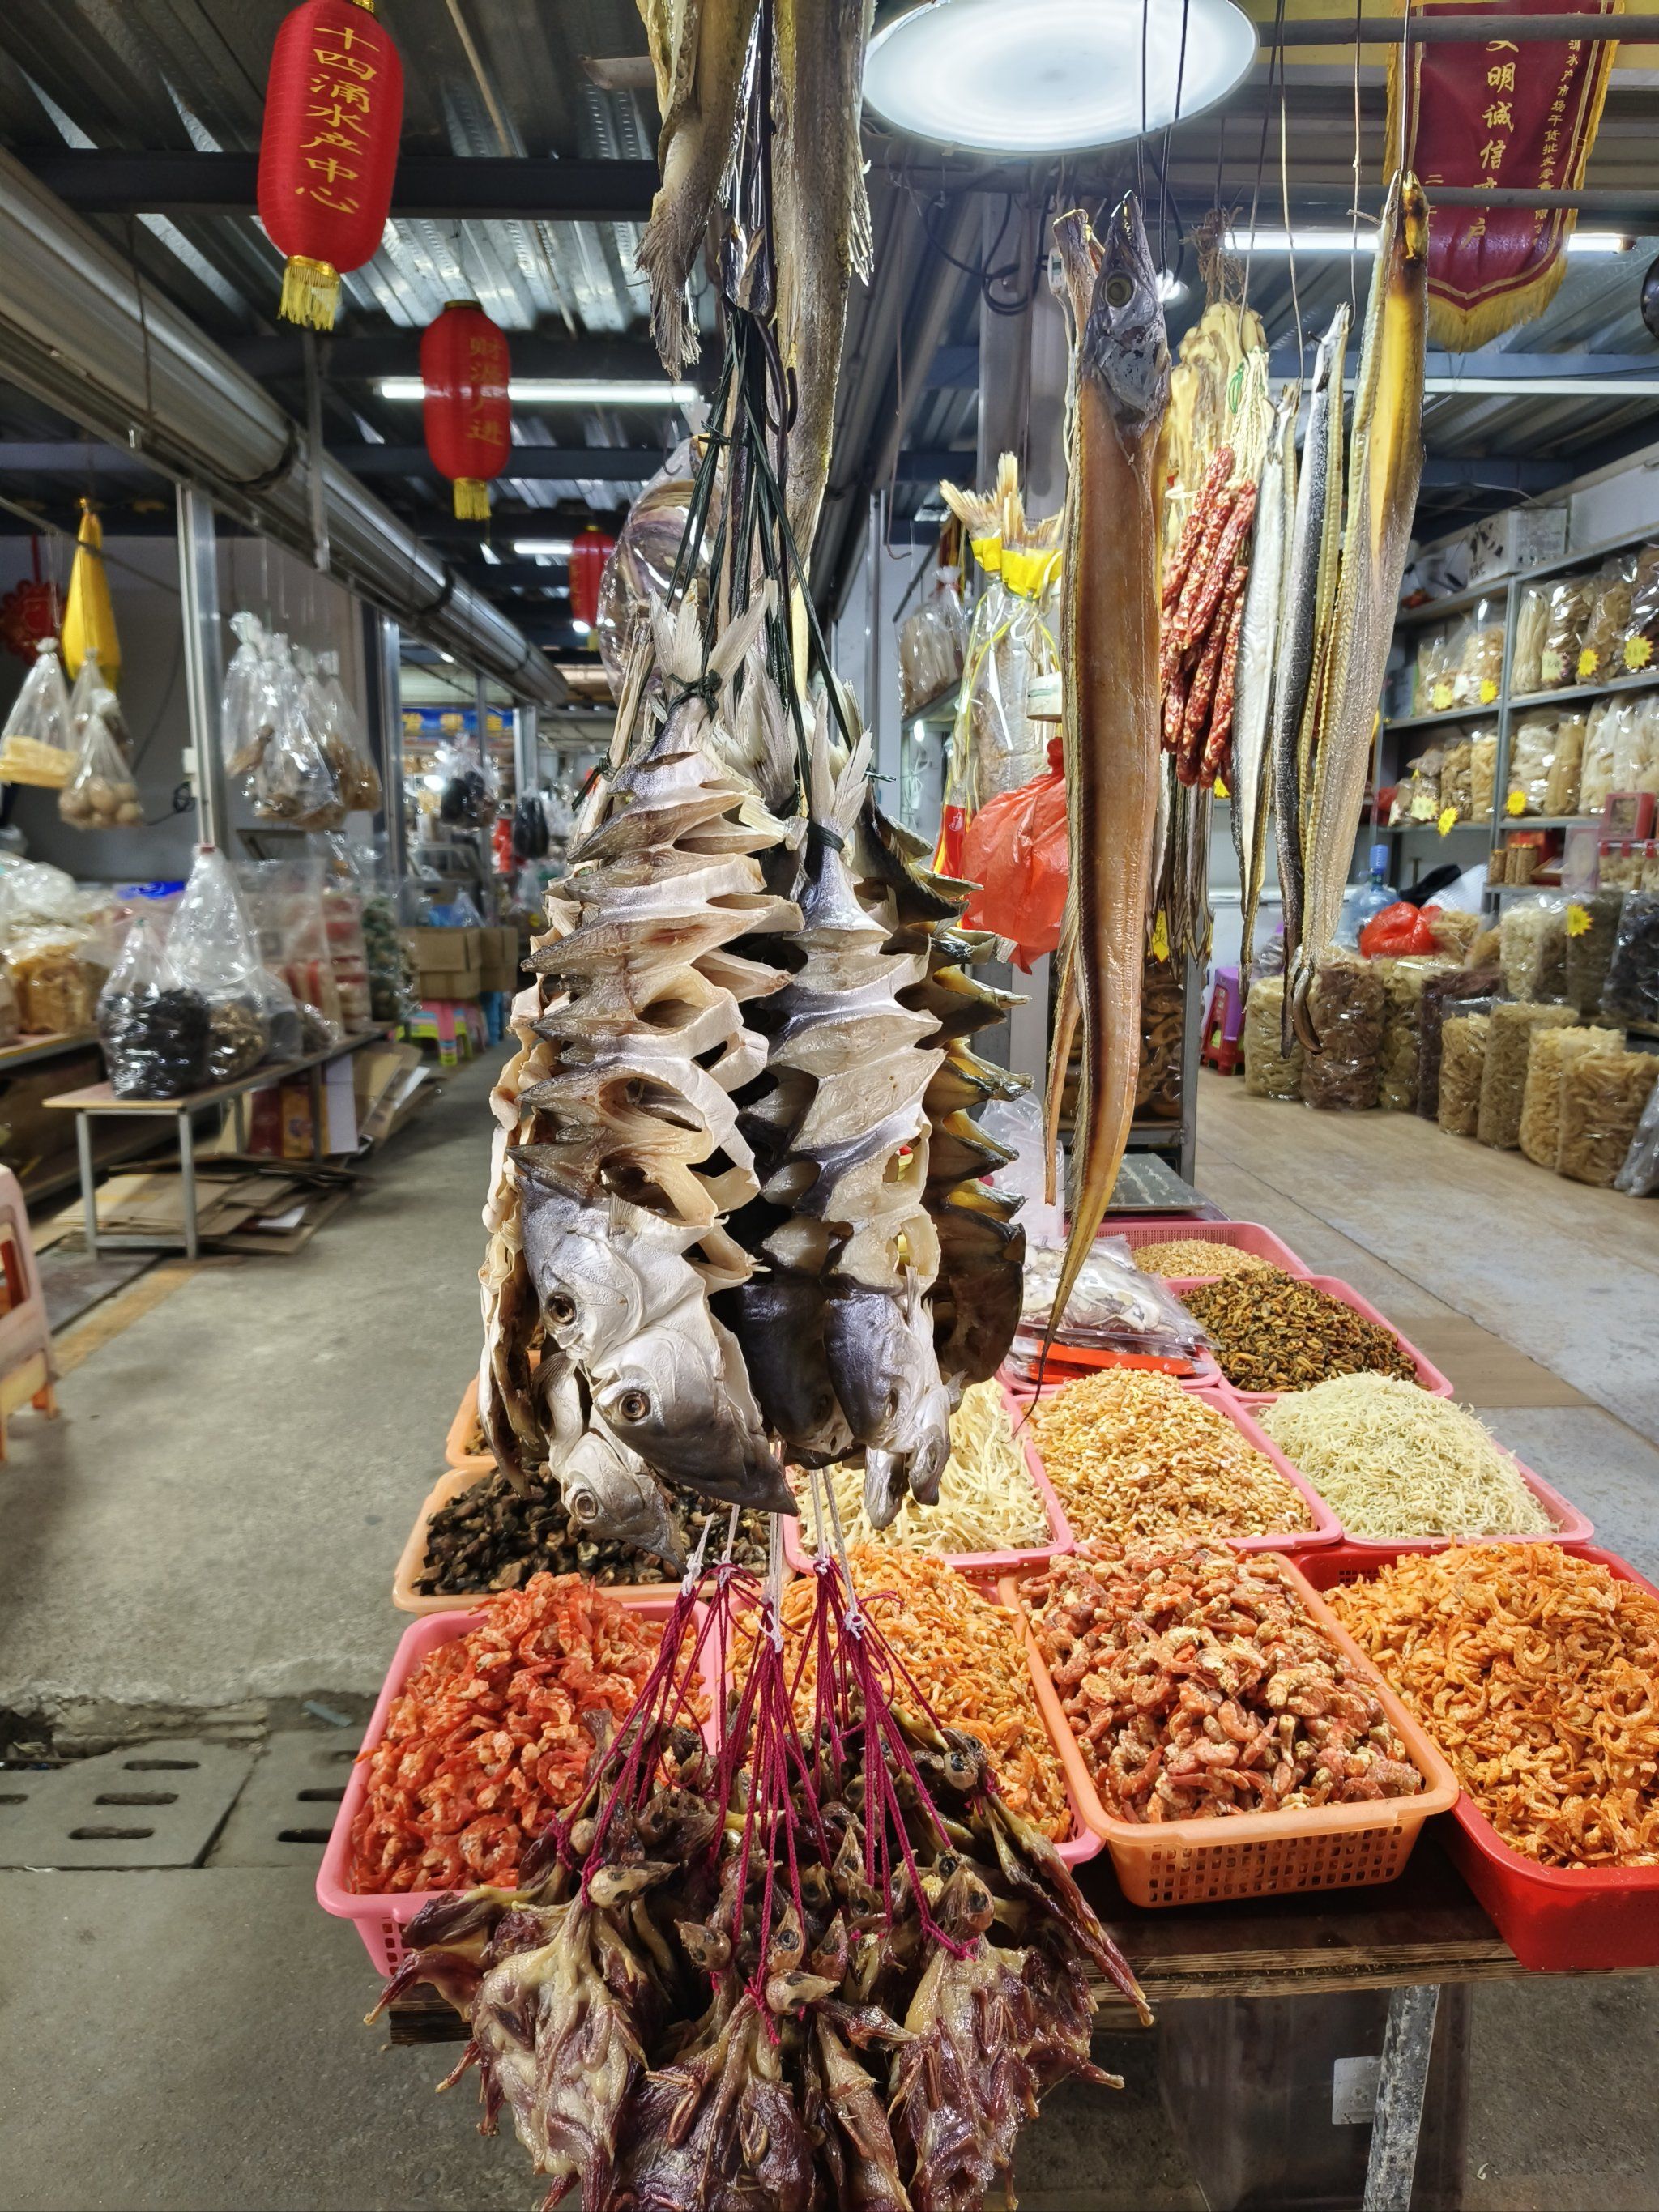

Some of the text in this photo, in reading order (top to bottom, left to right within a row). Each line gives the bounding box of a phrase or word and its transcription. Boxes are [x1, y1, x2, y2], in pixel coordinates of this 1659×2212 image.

[294, 27, 380, 214] 十四涌水产中心
